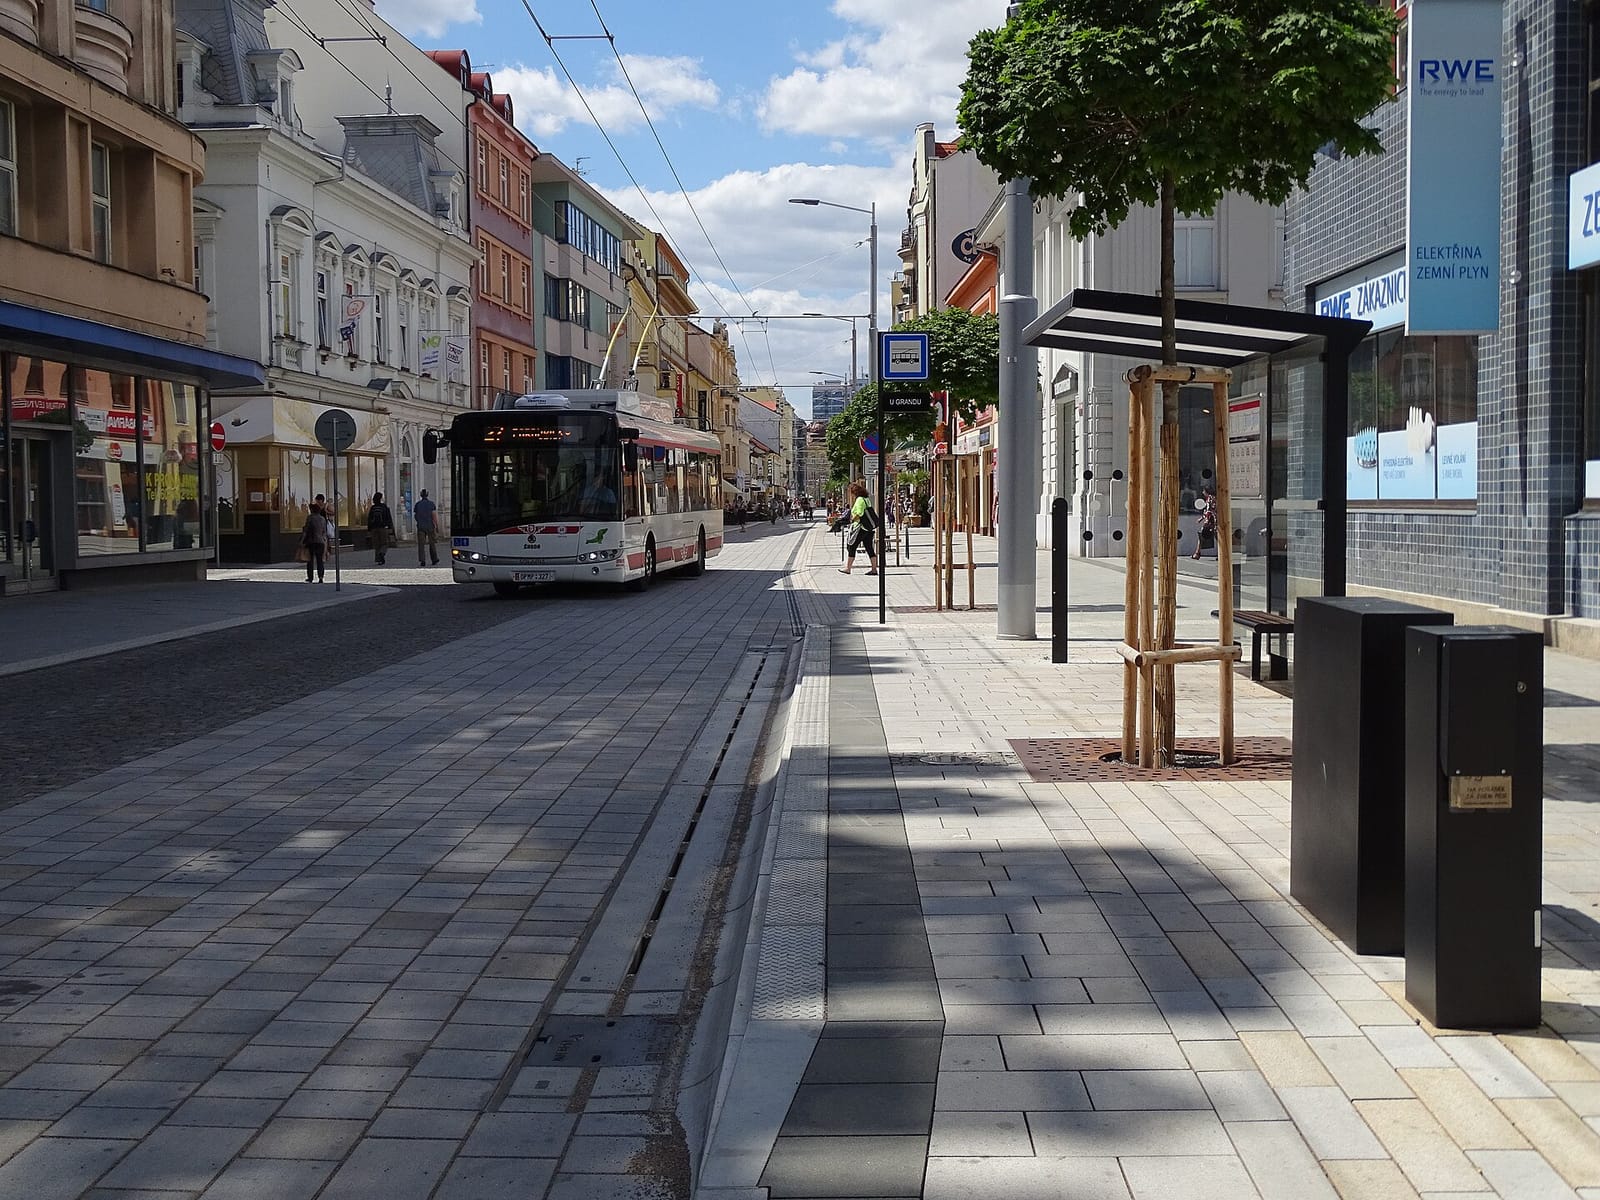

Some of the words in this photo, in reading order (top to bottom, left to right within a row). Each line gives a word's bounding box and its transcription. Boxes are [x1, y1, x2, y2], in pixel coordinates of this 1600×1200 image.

[1419, 59, 1494, 81] RWE
[1420, 87, 1432, 96] The
[1434, 88, 1458, 98] energy
[1460, 87, 1467, 96] to
[1469, 87, 1484, 96] lead
[1416, 243, 1482, 260] ELEKTŘINA
[1416, 264, 1455, 279] ZEMNÍ
[1459, 266, 1489, 279] PLYN
[1320, 291, 1351, 319] RWE
[889, 398, 895, 406] U
[895, 398, 922, 406] GRANDU
